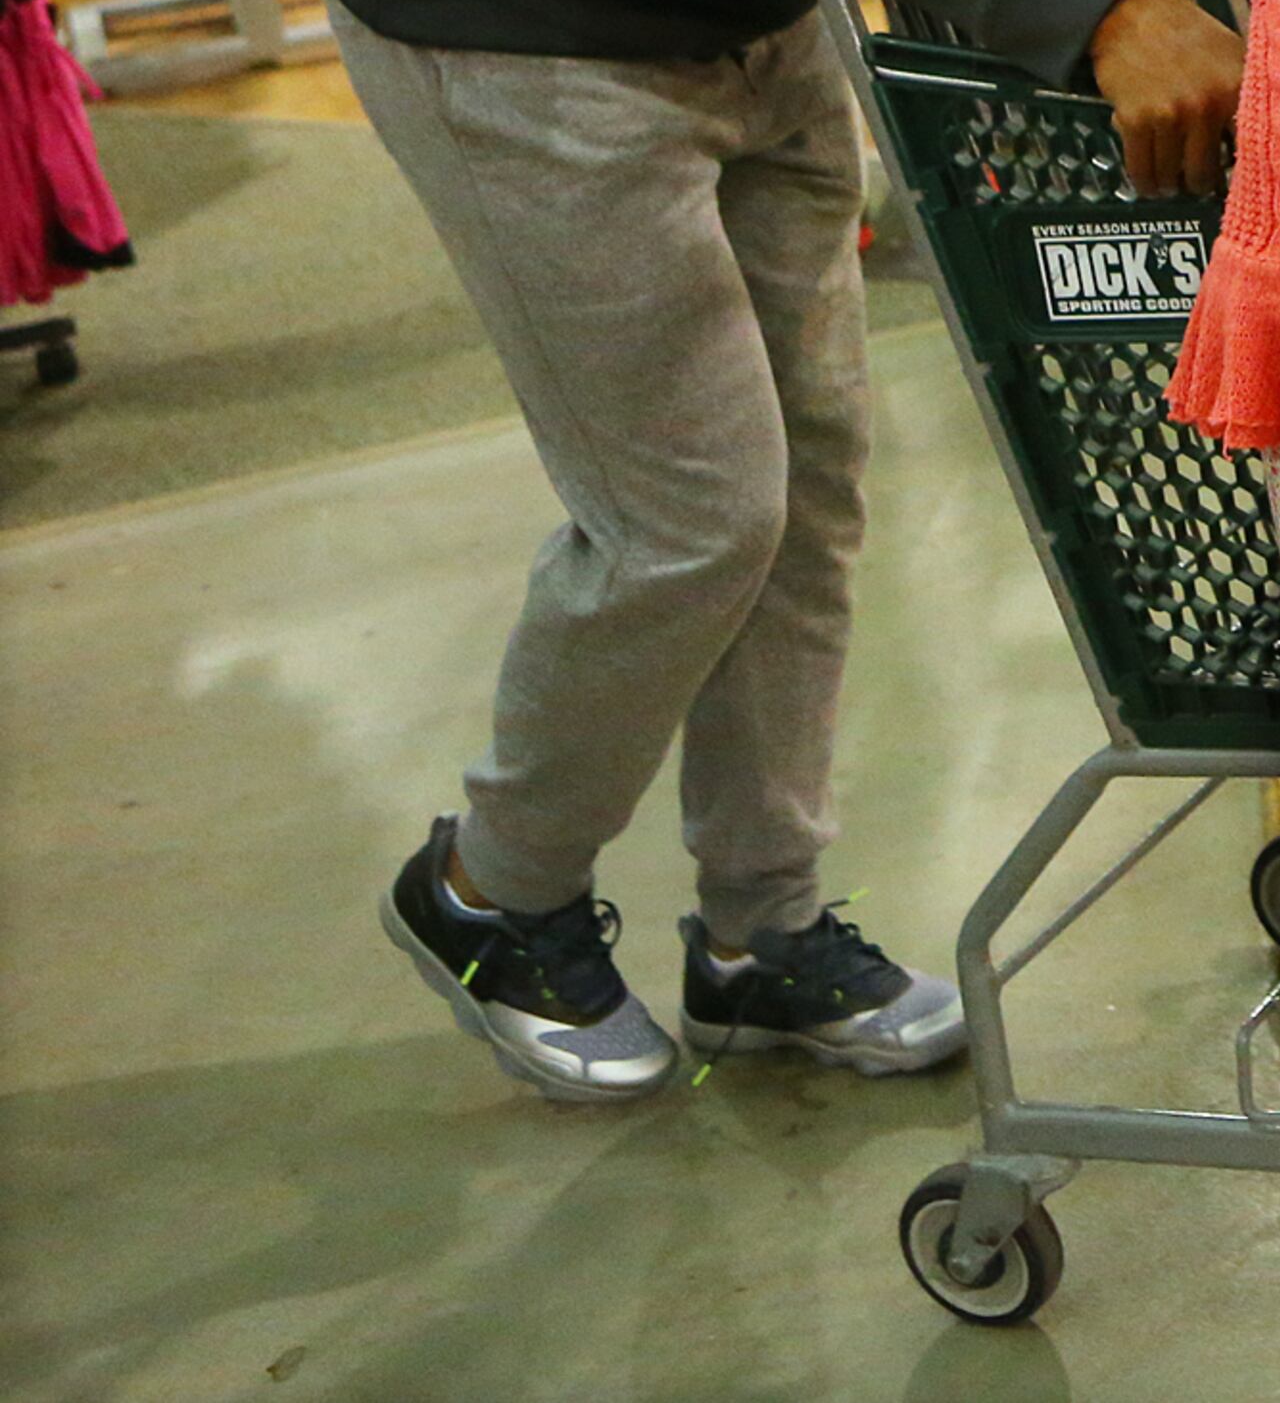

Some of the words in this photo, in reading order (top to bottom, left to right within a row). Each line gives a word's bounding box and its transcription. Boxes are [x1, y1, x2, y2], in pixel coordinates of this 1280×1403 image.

[1031, 225, 1074, 237] EVERY
[1077, 222, 1130, 236] SEASON
[1132, 220, 1182, 234] STARTS
[1184, 220, 1200, 232] AT
[1044, 241, 1202, 299] DICK'S
[1057, 298, 1142, 314] SPORTING
[1145, 297, 1198, 312] GOOD
